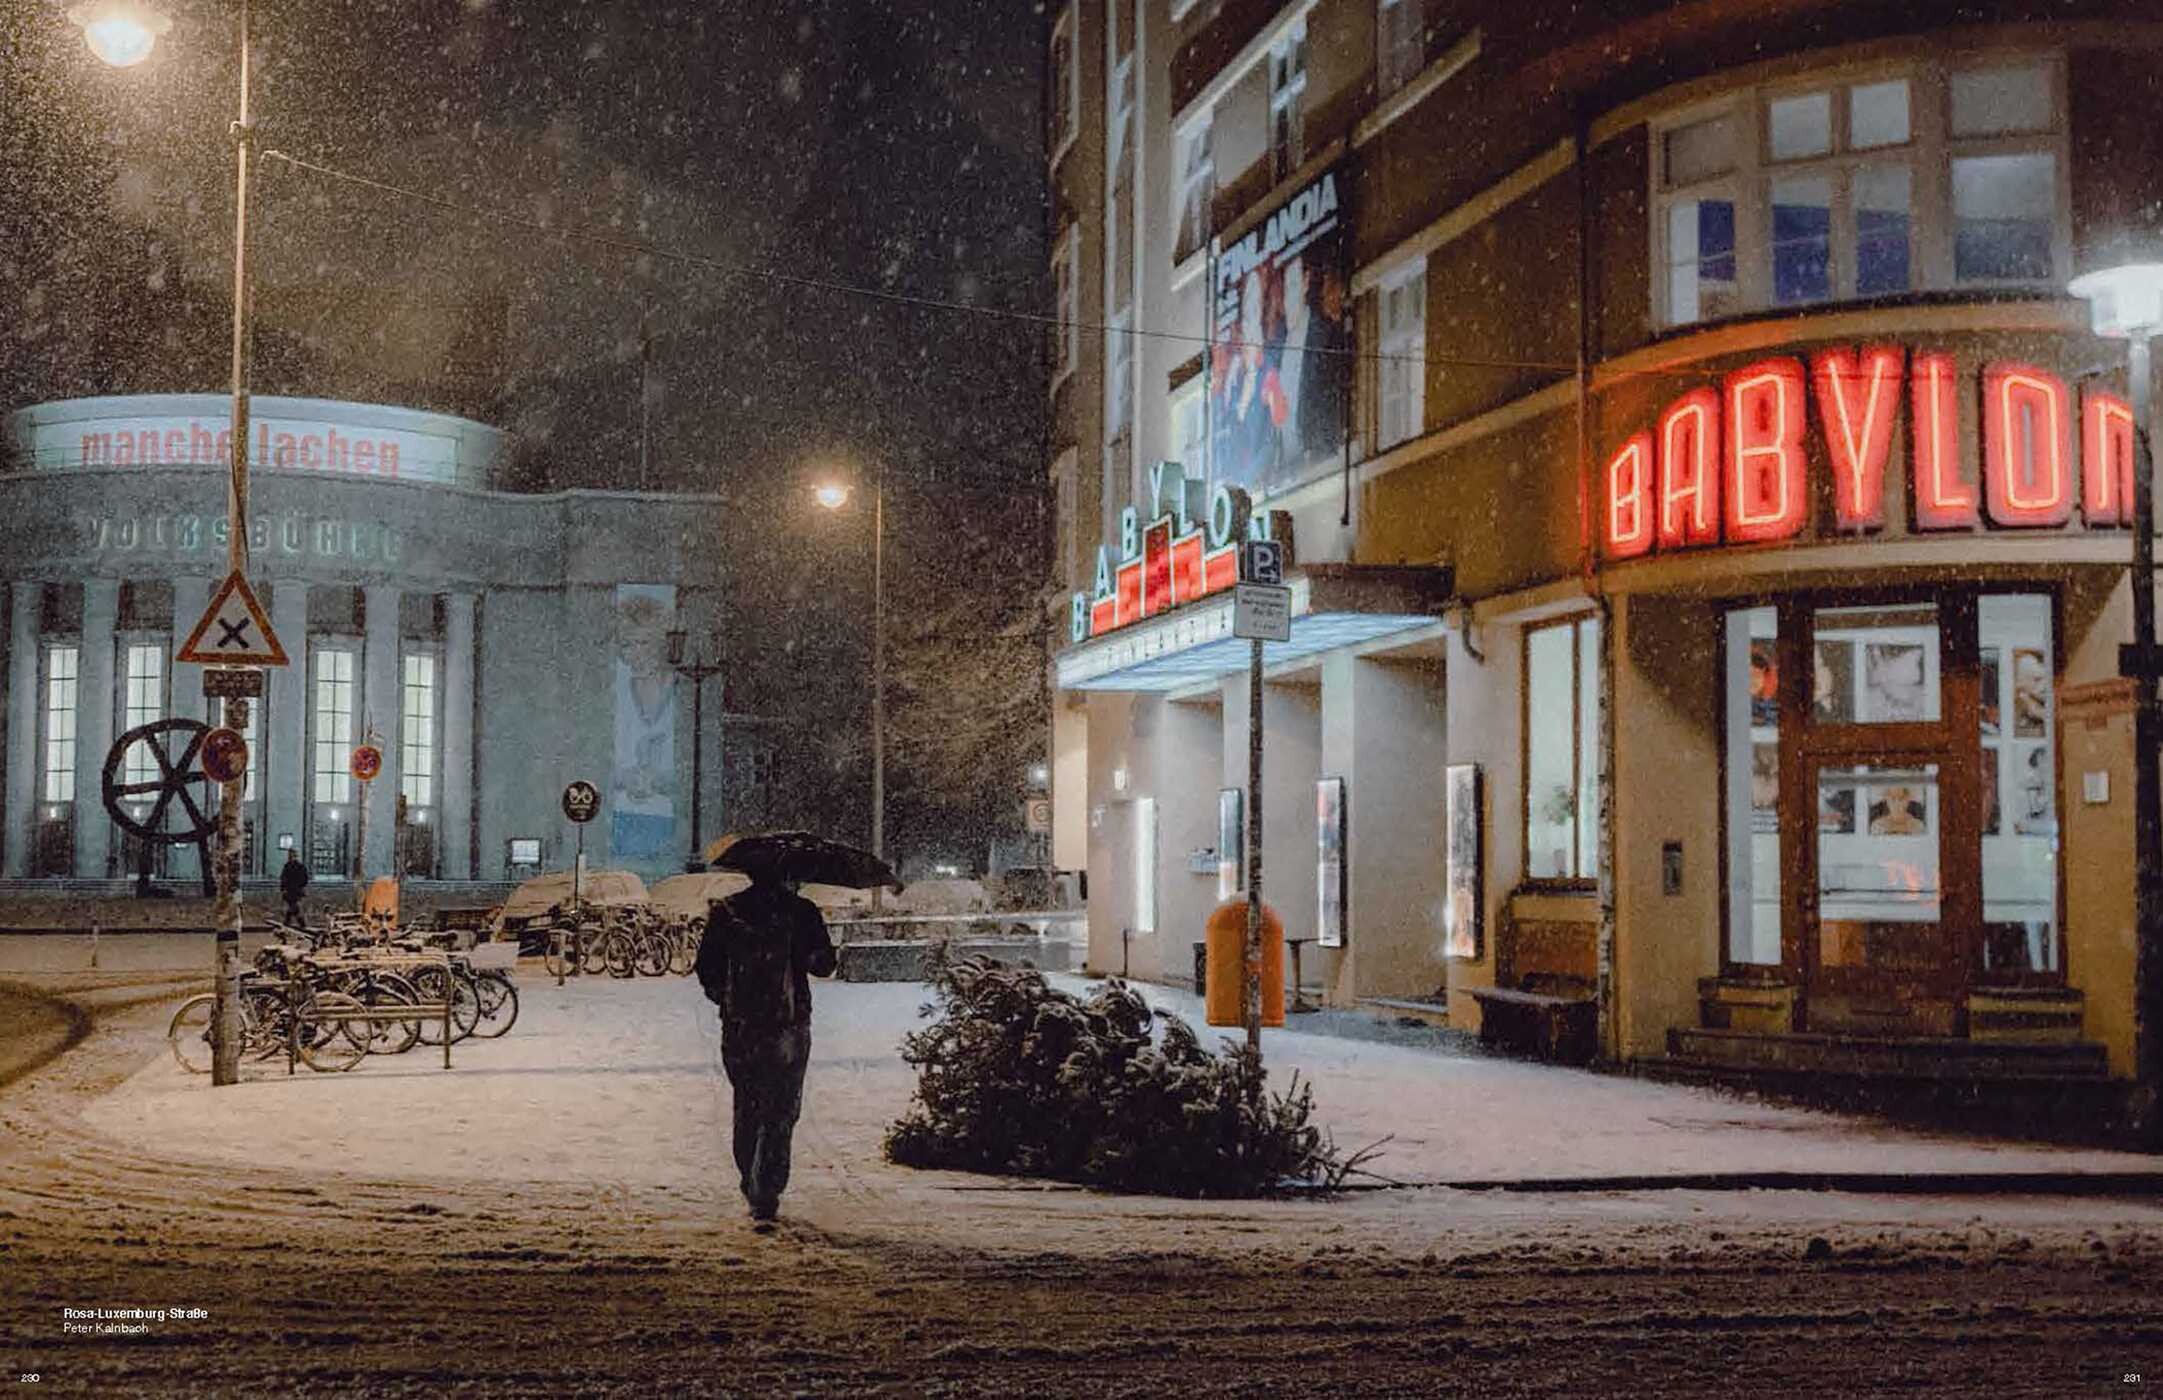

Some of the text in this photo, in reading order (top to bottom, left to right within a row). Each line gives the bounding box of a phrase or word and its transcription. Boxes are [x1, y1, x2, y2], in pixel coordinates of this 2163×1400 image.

[1217, 172, 1339, 293] FINLANDIA
[80, 421, 400, 480] manche lachen
[1604, 344, 2134, 557] BABYLON
[1254, 546, 1274, 578] P
